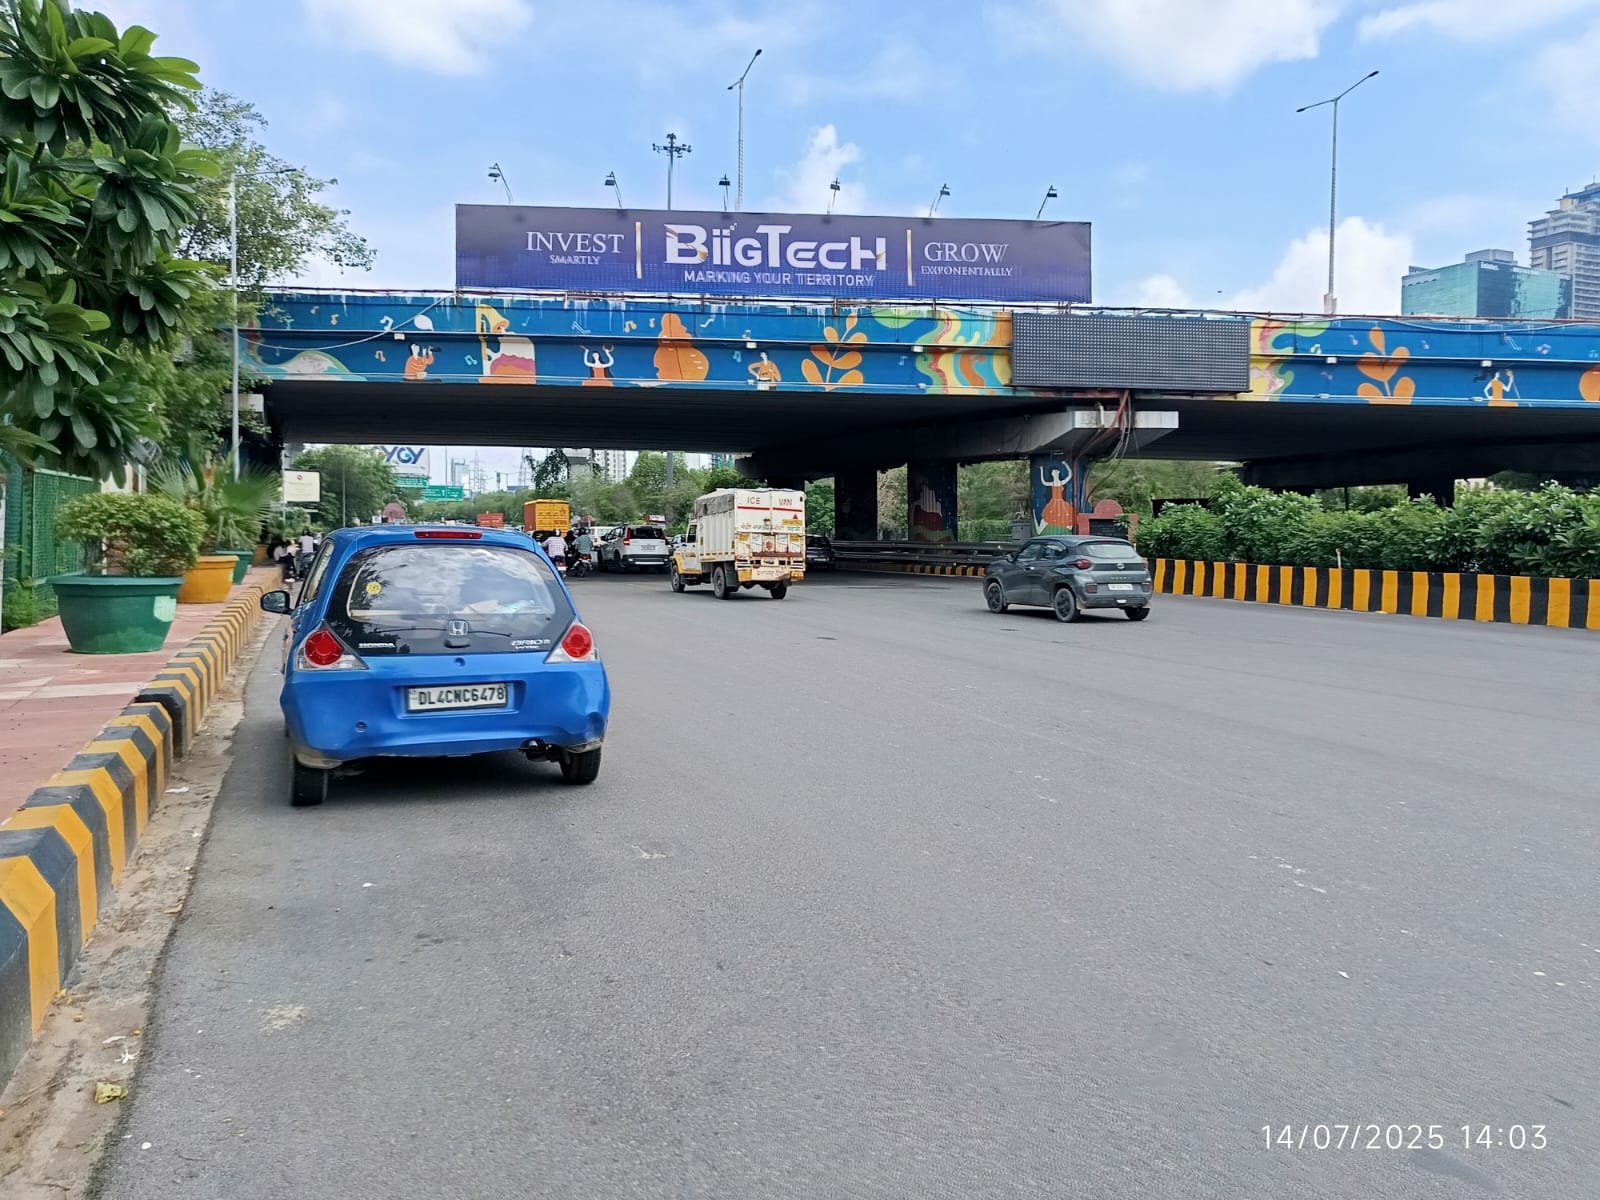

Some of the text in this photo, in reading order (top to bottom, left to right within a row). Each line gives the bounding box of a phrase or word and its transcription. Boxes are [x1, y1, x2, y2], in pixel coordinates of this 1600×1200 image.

[525, 231, 625, 254] INVEST
[549, 254, 601, 265] SMARTLY
[924, 241, 1009, 263] GROW
[684, 269, 874, 287] MARKING YOUR TERRITORY
[920, 265, 1013, 277] EXPONENTIALLY
[747, 496, 762, 505] ICE
[418, 686, 505, 706] DL4CNC6478
